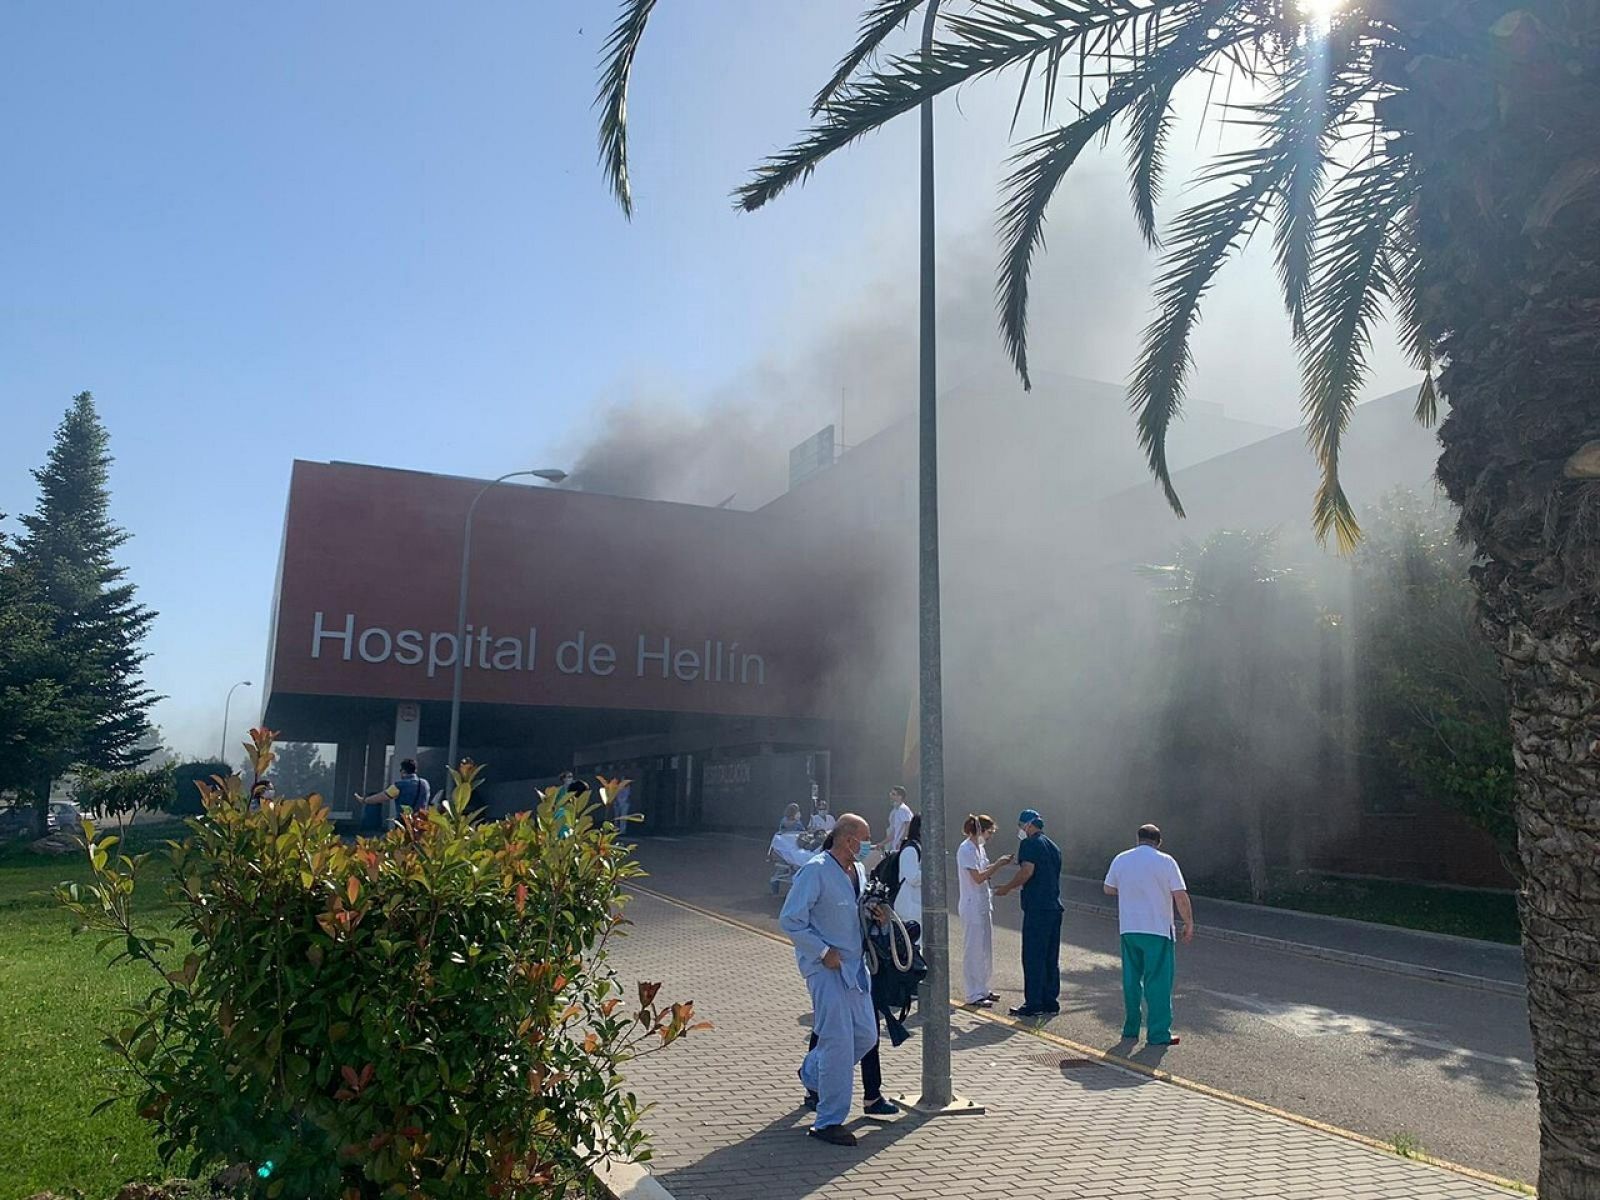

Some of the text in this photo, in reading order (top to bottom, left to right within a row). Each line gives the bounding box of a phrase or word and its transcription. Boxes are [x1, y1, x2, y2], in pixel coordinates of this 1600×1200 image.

[311, 611, 765, 685] Hospital de Hellín
